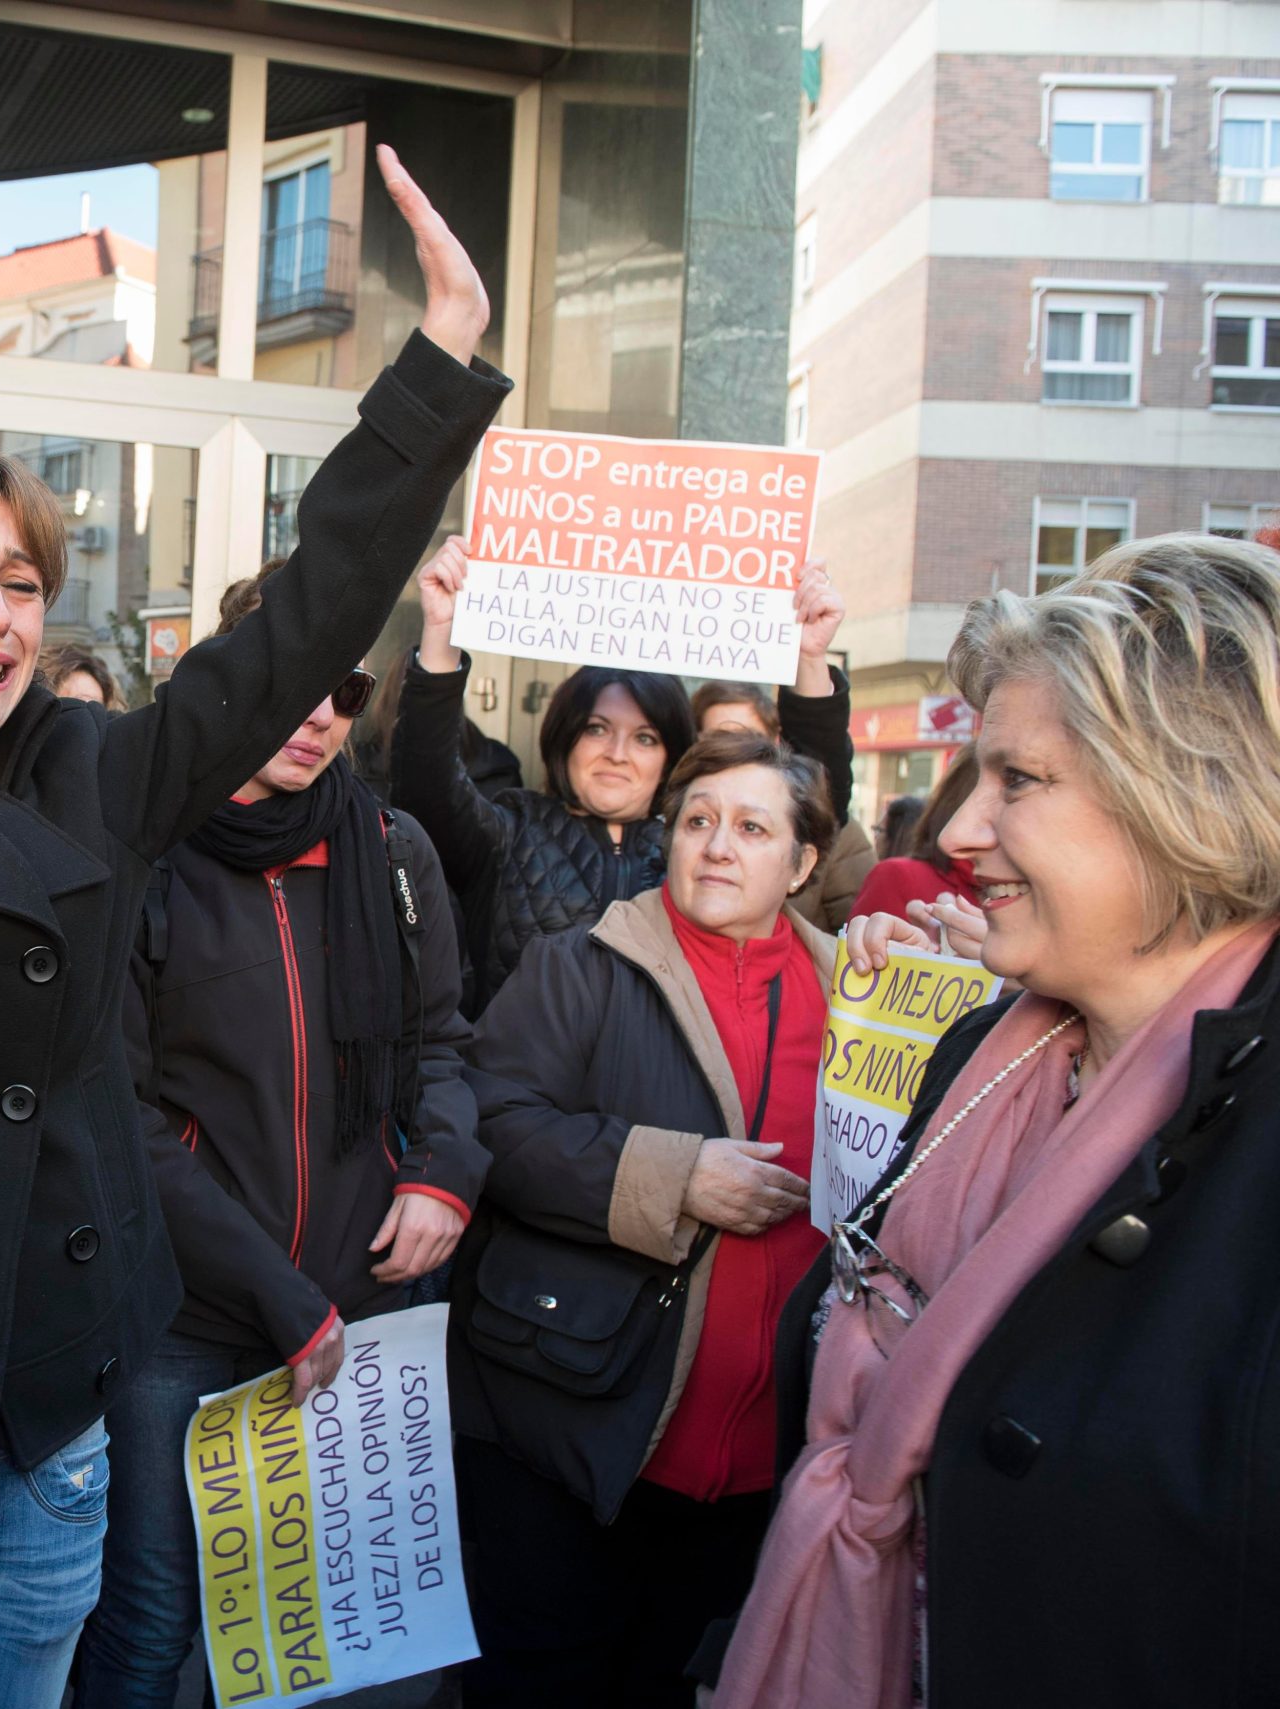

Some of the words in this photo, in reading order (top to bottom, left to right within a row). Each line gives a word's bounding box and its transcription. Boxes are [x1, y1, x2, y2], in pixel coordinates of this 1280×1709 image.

[489, 438, 601, 481] STOP
[608, 460, 749, 500] entrega
[758, 464, 807, 499] de
[482, 484, 596, 526] NIÑOS
[603, 505, 621, 528] a
[630, 507, 673, 532] un
[683, 502, 804, 544] PADRE
[478, 524, 795, 588] MALTRATADOR
[466, 592, 564, 625] HALLA,
[577, 603, 670, 634] DIGAN
[682, 613, 718, 639] LO
[730, 619, 792, 647] QUE
[497, 569, 529, 592] LA
[540, 572, 666, 605] JUSTICIA
[679, 586, 722, 610] NO
[733, 590, 766, 615] SE
[487, 620, 579, 652] DIGAN
[590, 632, 626, 657] EN
[638, 639, 671, 662] LA
[684, 643, 760, 671] HAYA
[397, 868, 417, 924] Quechua
[349, 1340, 390, 1476] OPINIÓN
[399, 1364, 434, 1478] NIÑOS?
[311, 1389, 355, 1587] ESCUCHADO
[366, 1480, 394, 1523] LA
[410, 1483, 439, 1542] LOS
[211, 1526, 249, 1579] LO
[269, 1492, 309, 1570] LOS
[369, 1526, 408, 1637] JUEZ/A
[415, 1547, 444, 1592] DE
[275, 1575, 326, 1692] PARA
[331, 1591, 372, 1652] ¿HA
